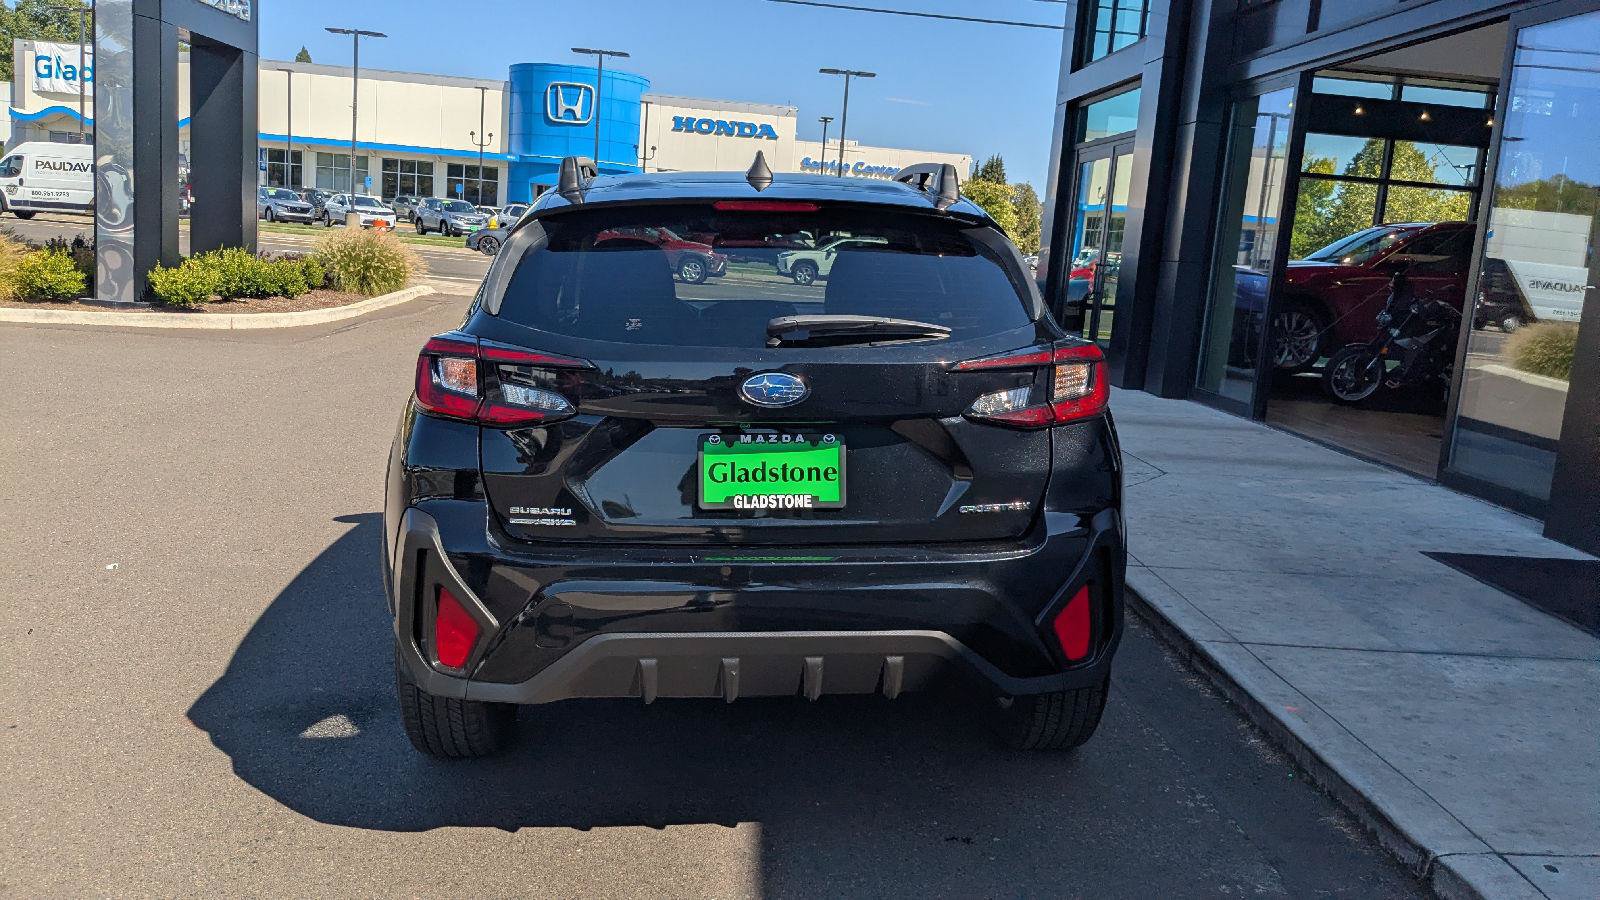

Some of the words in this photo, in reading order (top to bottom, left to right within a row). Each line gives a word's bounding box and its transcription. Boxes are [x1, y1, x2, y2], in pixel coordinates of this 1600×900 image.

[672, 115, 779, 140] HONDA
[740, 433, 805, 443] MAZDA
[708, 461, 838, 483] Gladstone
[733, 494, 813, 509] GLADSTONE
[509, 506, 572, 516] SUBARU
